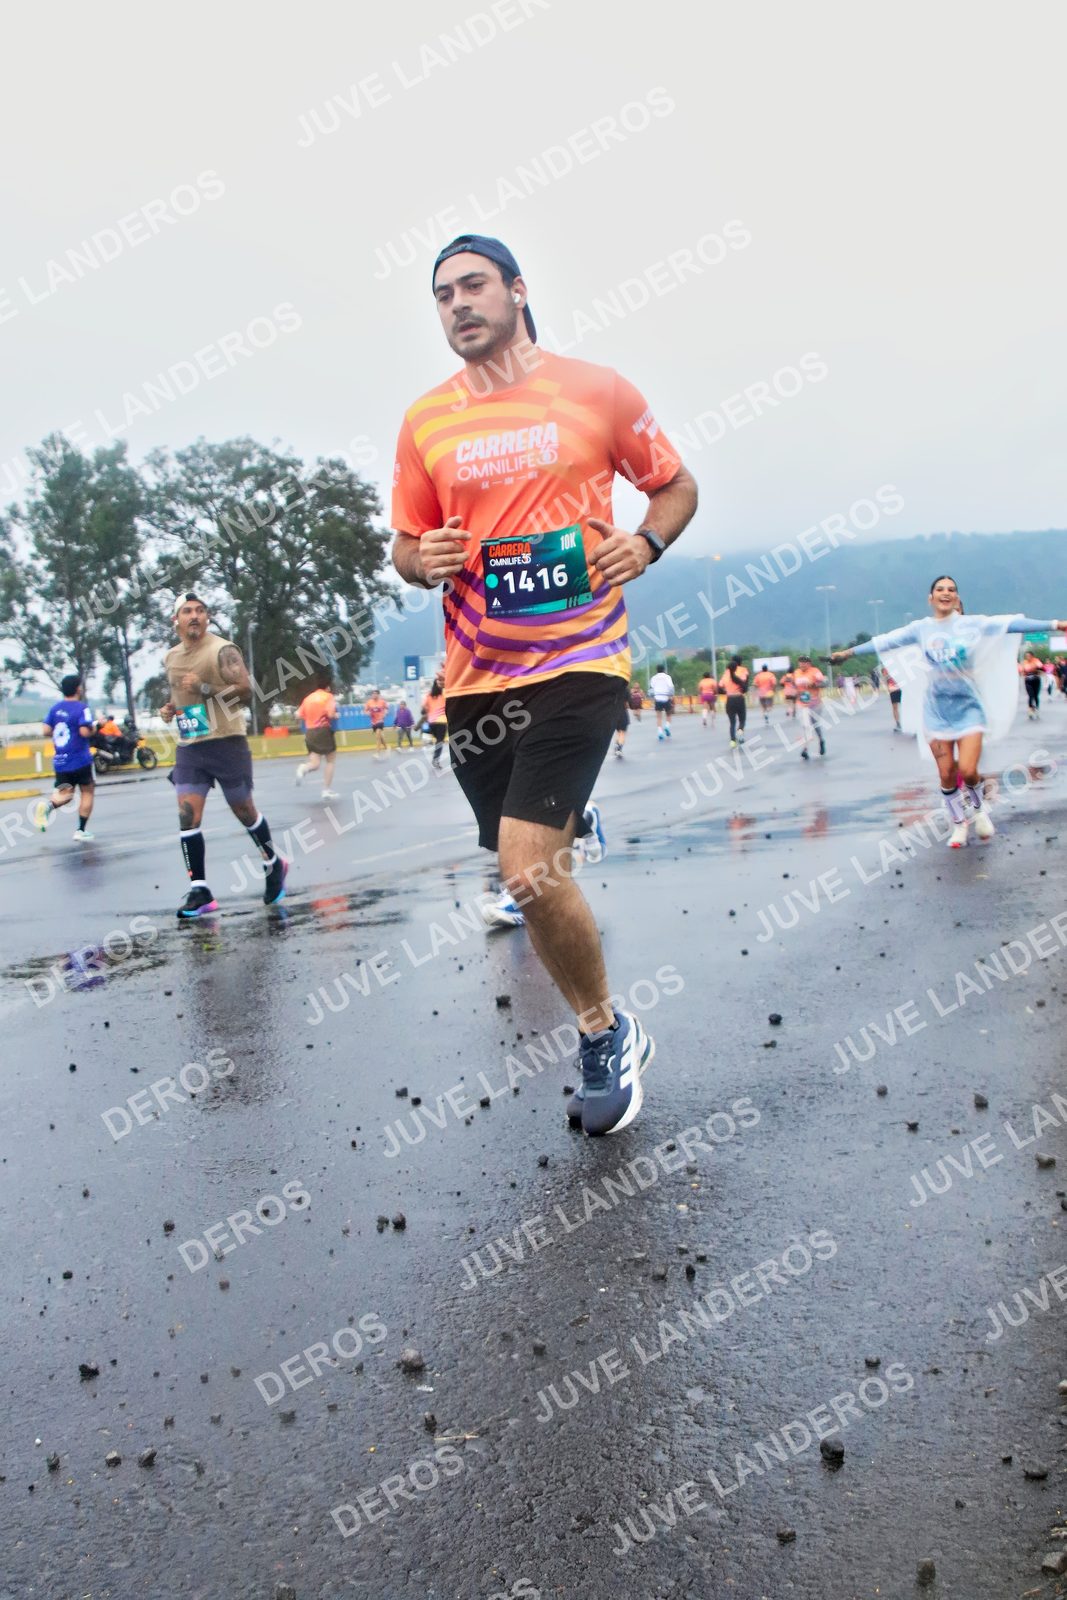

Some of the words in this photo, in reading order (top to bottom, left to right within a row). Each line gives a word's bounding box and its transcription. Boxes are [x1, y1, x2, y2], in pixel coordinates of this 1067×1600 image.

[456, 422, 559, 464] CARRERA
[457, 451, 537, 481] OMNILIFE
[489, 542, 531, 558] CARRERA
[560, 532, 576, 551] 10K
[489, 556, 522, 566] OMNILIFE
[503, 563, 568, 594] 1416
[406, 665, 417, 679] E
